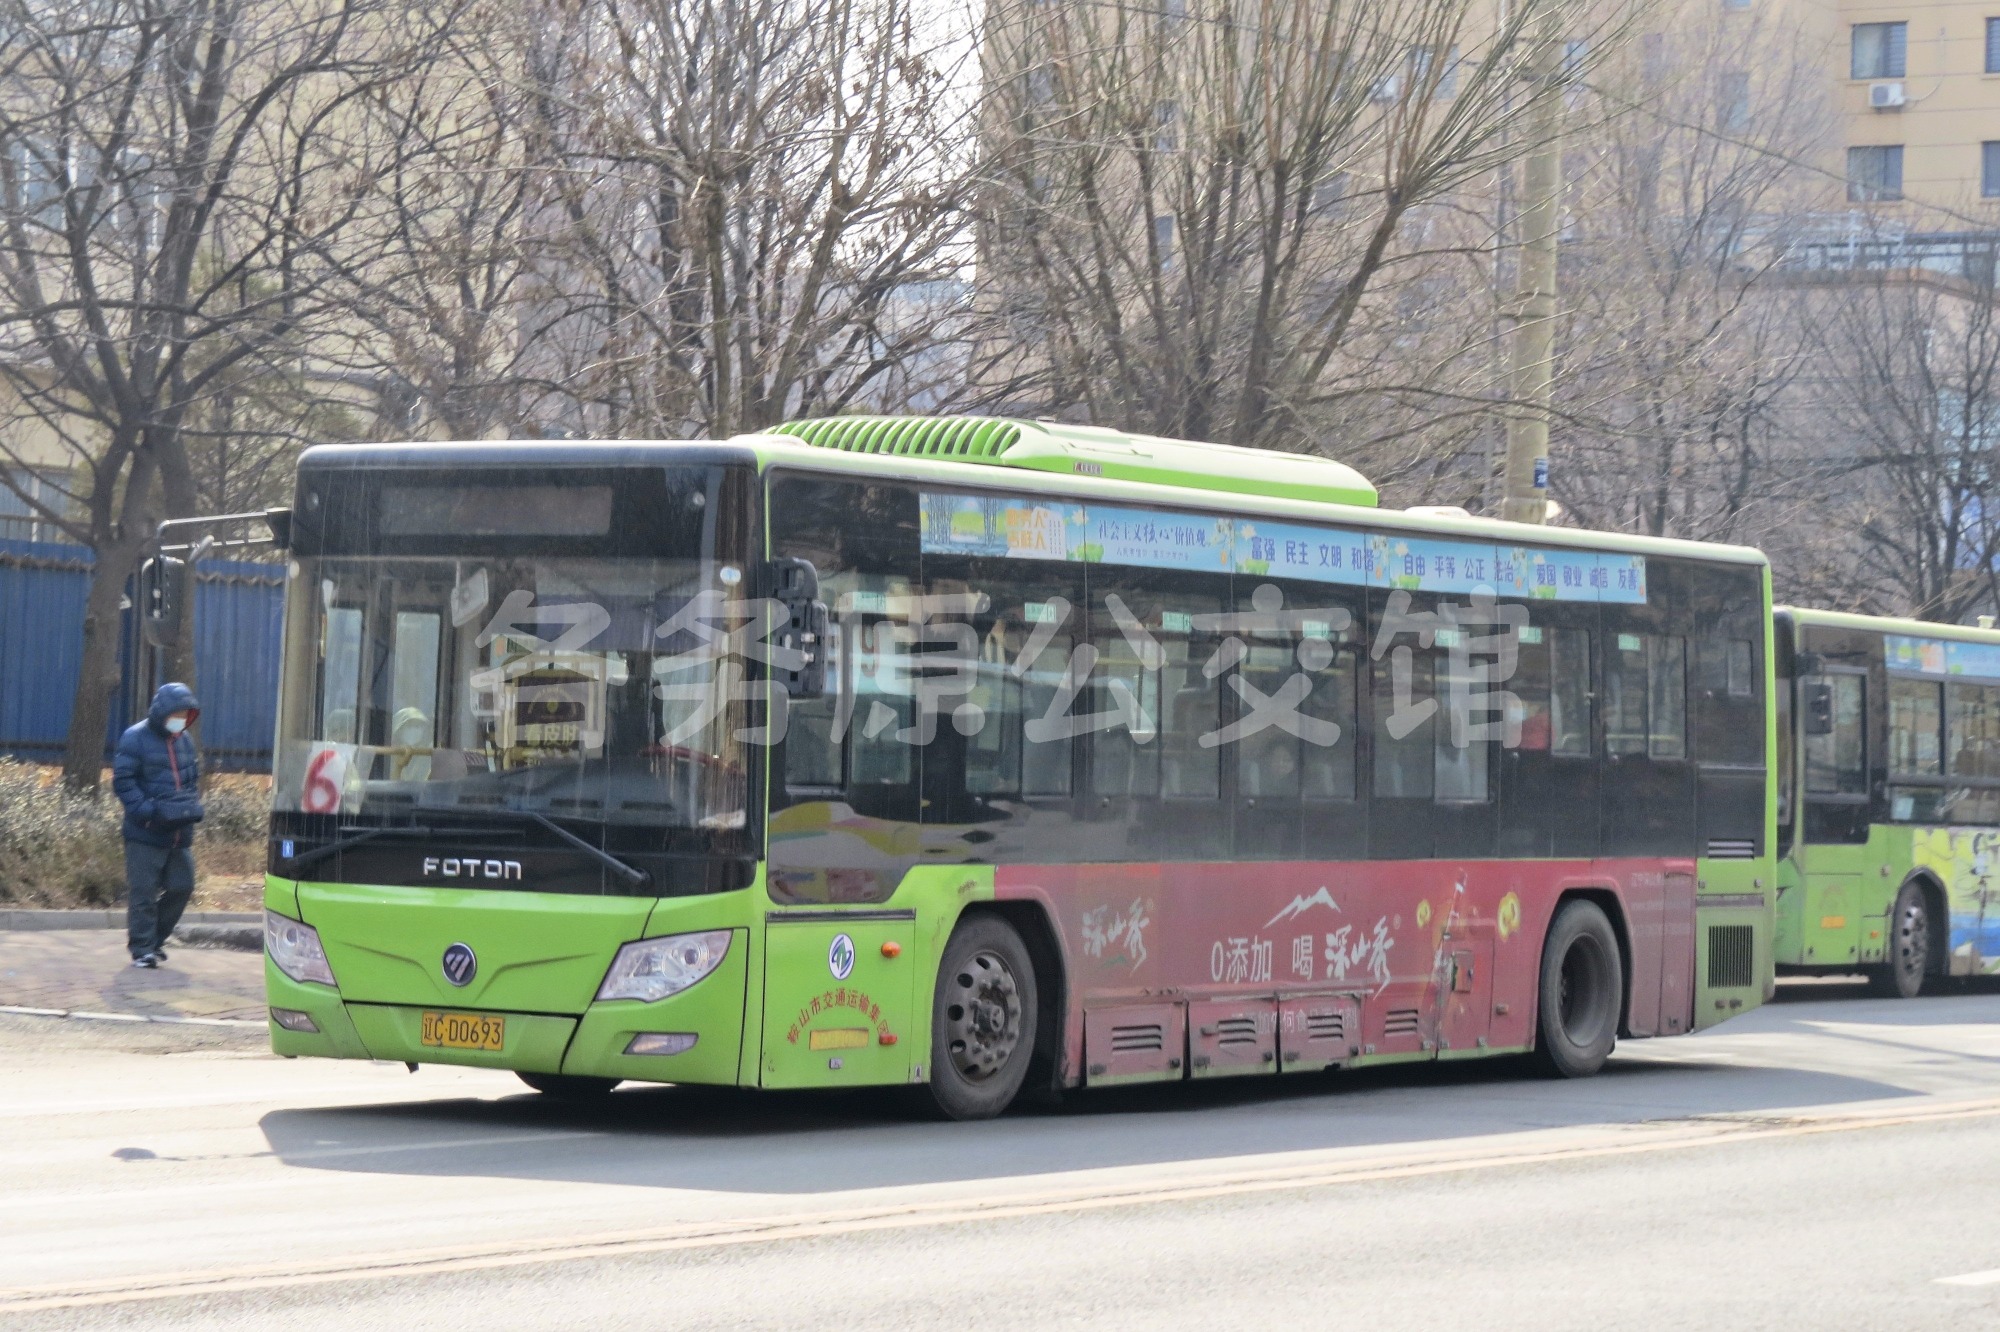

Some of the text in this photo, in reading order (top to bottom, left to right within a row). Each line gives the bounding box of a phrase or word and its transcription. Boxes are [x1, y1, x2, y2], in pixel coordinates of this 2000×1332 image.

[1252, 536, 1374, 571] 富强 民主 文明 和谐
[1404, 554, 1514, 583] 自由 平等 公正 法治
[1537, 564, 1639, 590] 爱国 敬业 诚信 友善
[302, 749, 338, 814] 6
[423, 857, 522, 880] FOTON
[1211, 935, 1273, 983] 0添加
[1292, 934, 1314, 981] 喝
